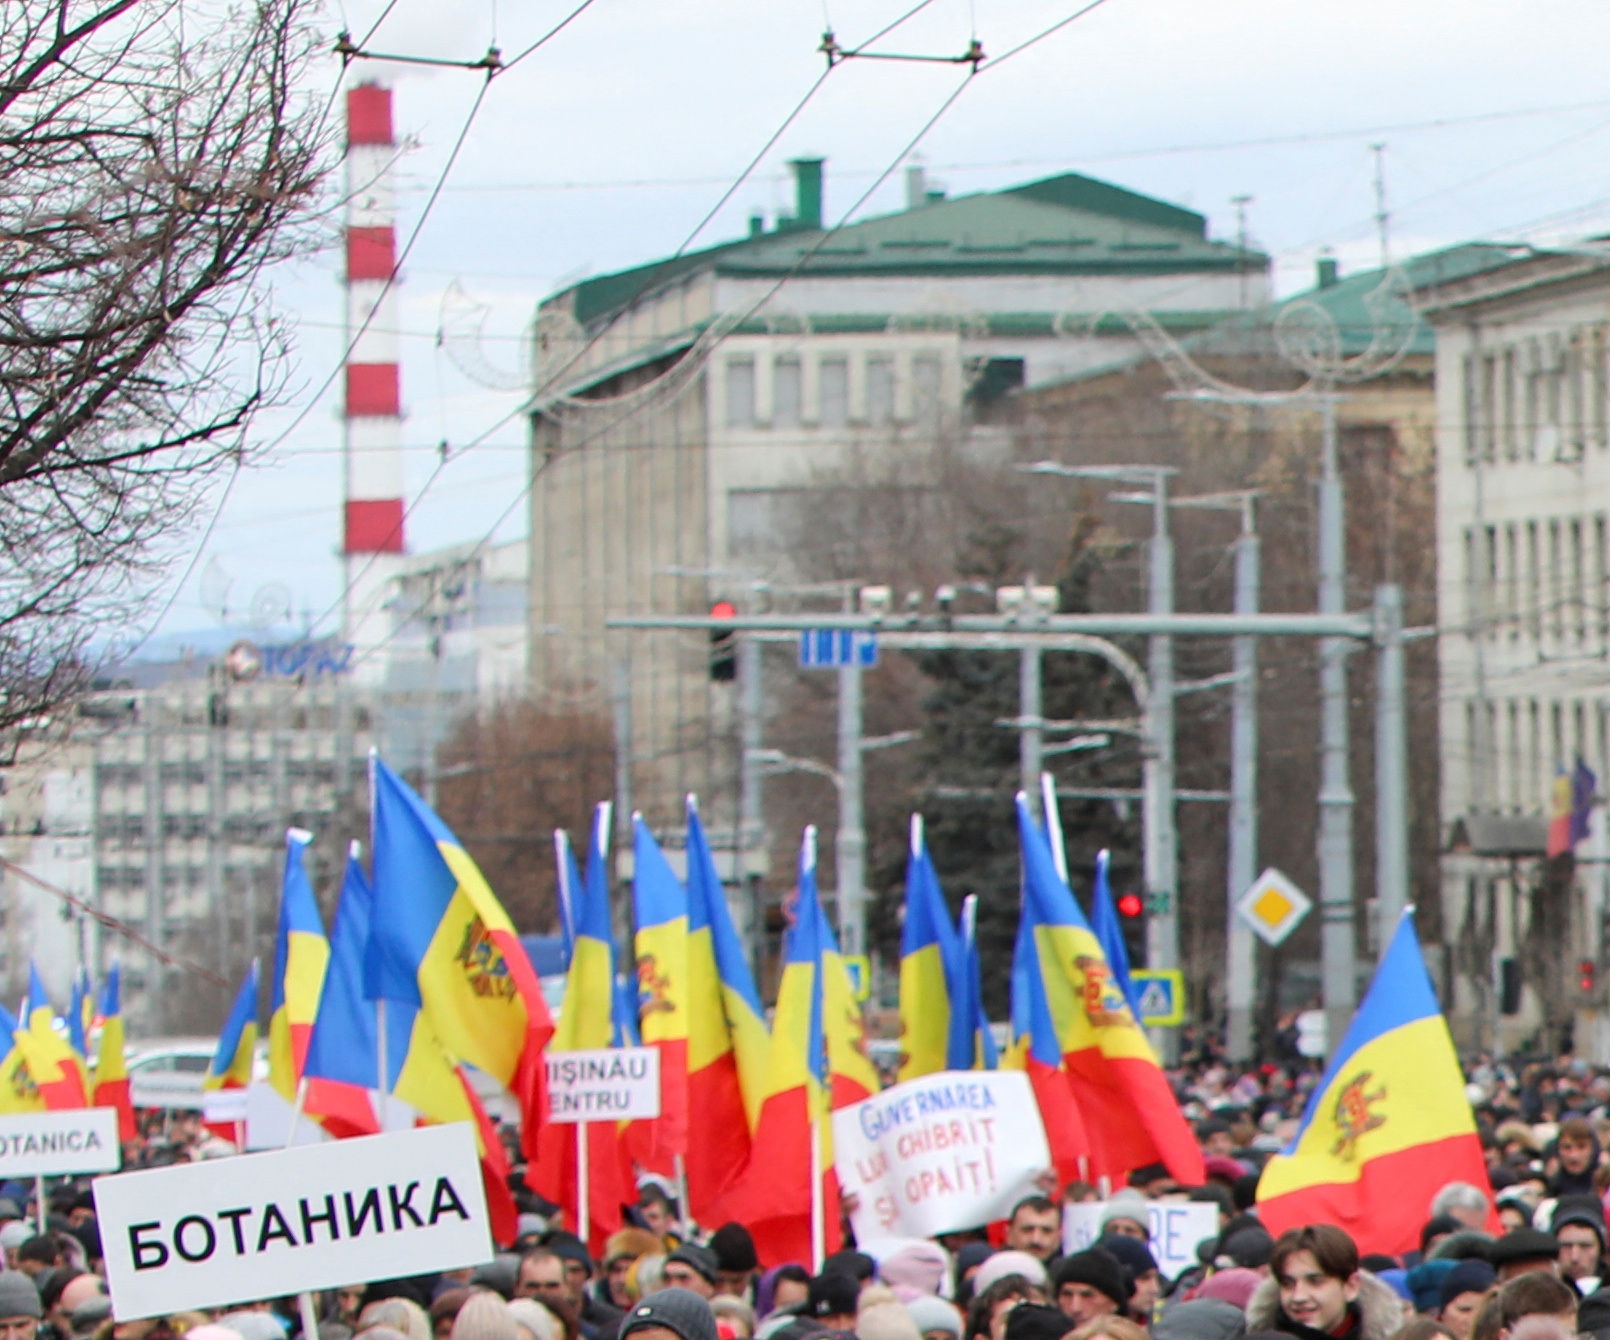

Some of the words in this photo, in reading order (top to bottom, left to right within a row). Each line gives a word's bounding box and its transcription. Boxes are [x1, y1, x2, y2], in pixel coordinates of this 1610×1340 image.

[545, 1055, 648, 1087] IȘINĂU
[549, 1090, 630, 1113] ENTRU
[127, 1175, 471, 1272] БОТАНИКА
